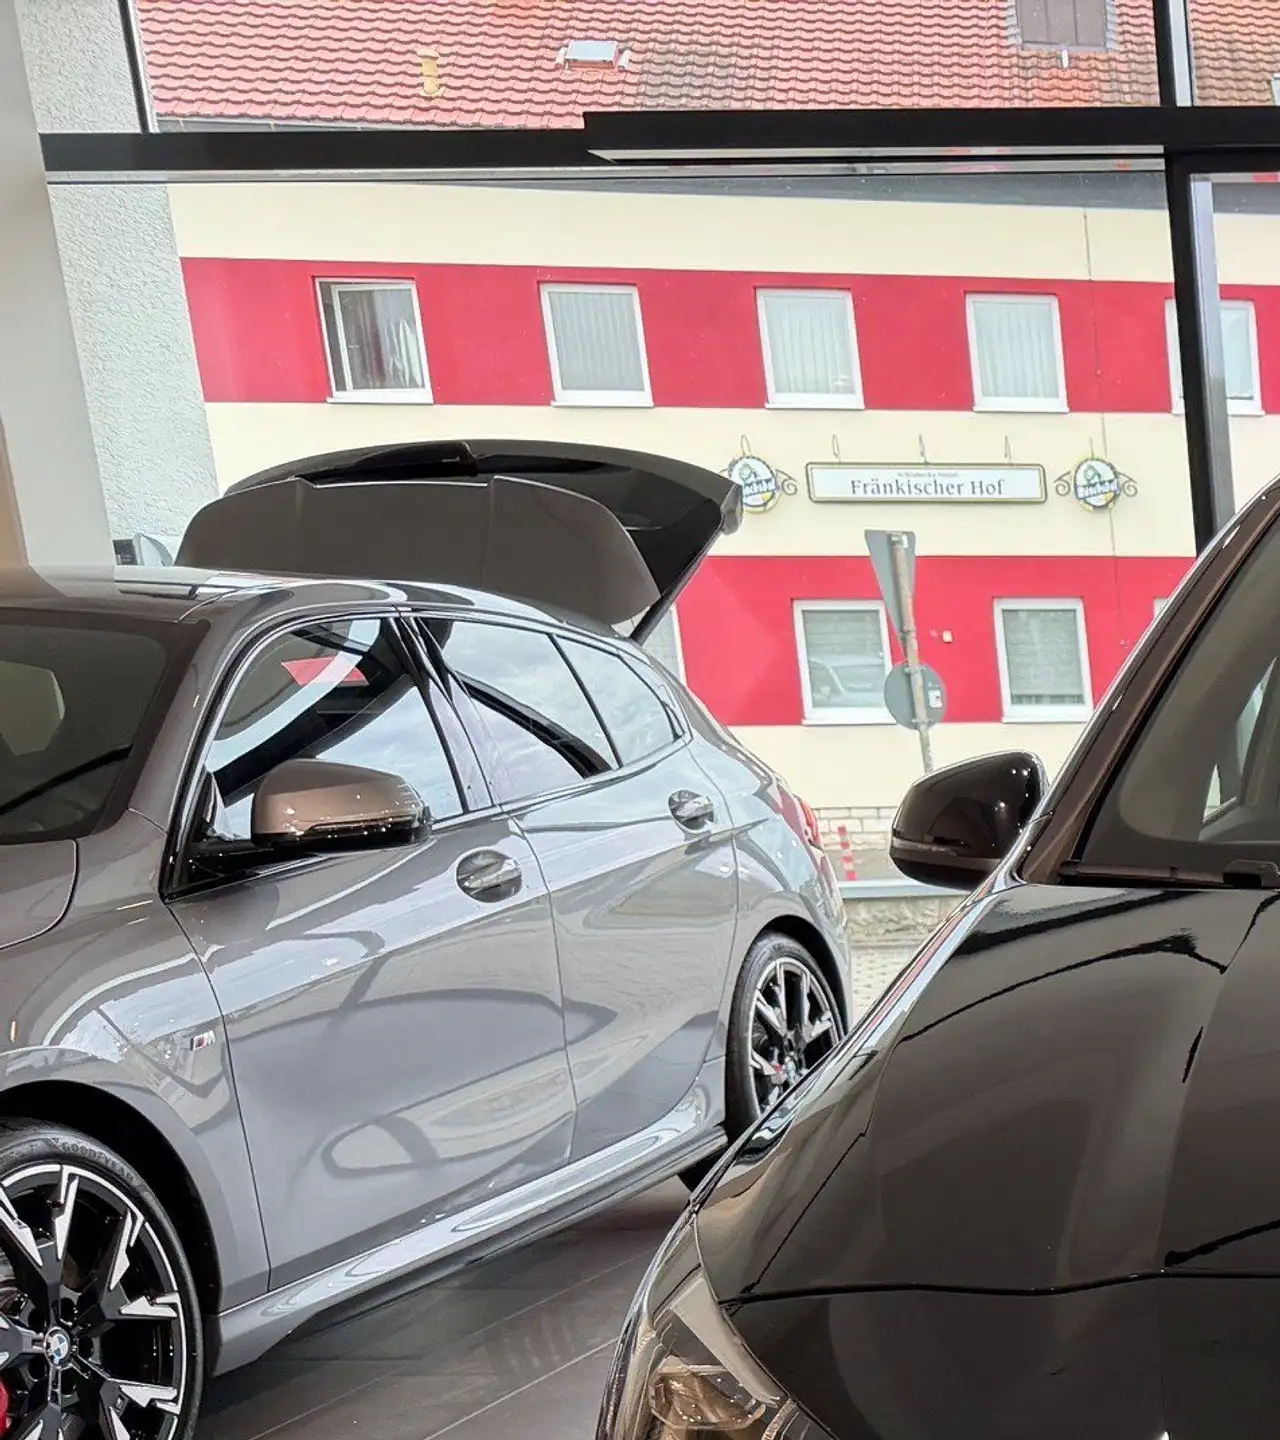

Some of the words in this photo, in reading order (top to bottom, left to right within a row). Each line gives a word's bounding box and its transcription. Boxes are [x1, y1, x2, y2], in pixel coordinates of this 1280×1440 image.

[851, 479, 962, 495] Fränkischer
[970, 479, 1005, 495] Hof
[62, 1139, 134, 1182] GOODYEAR
